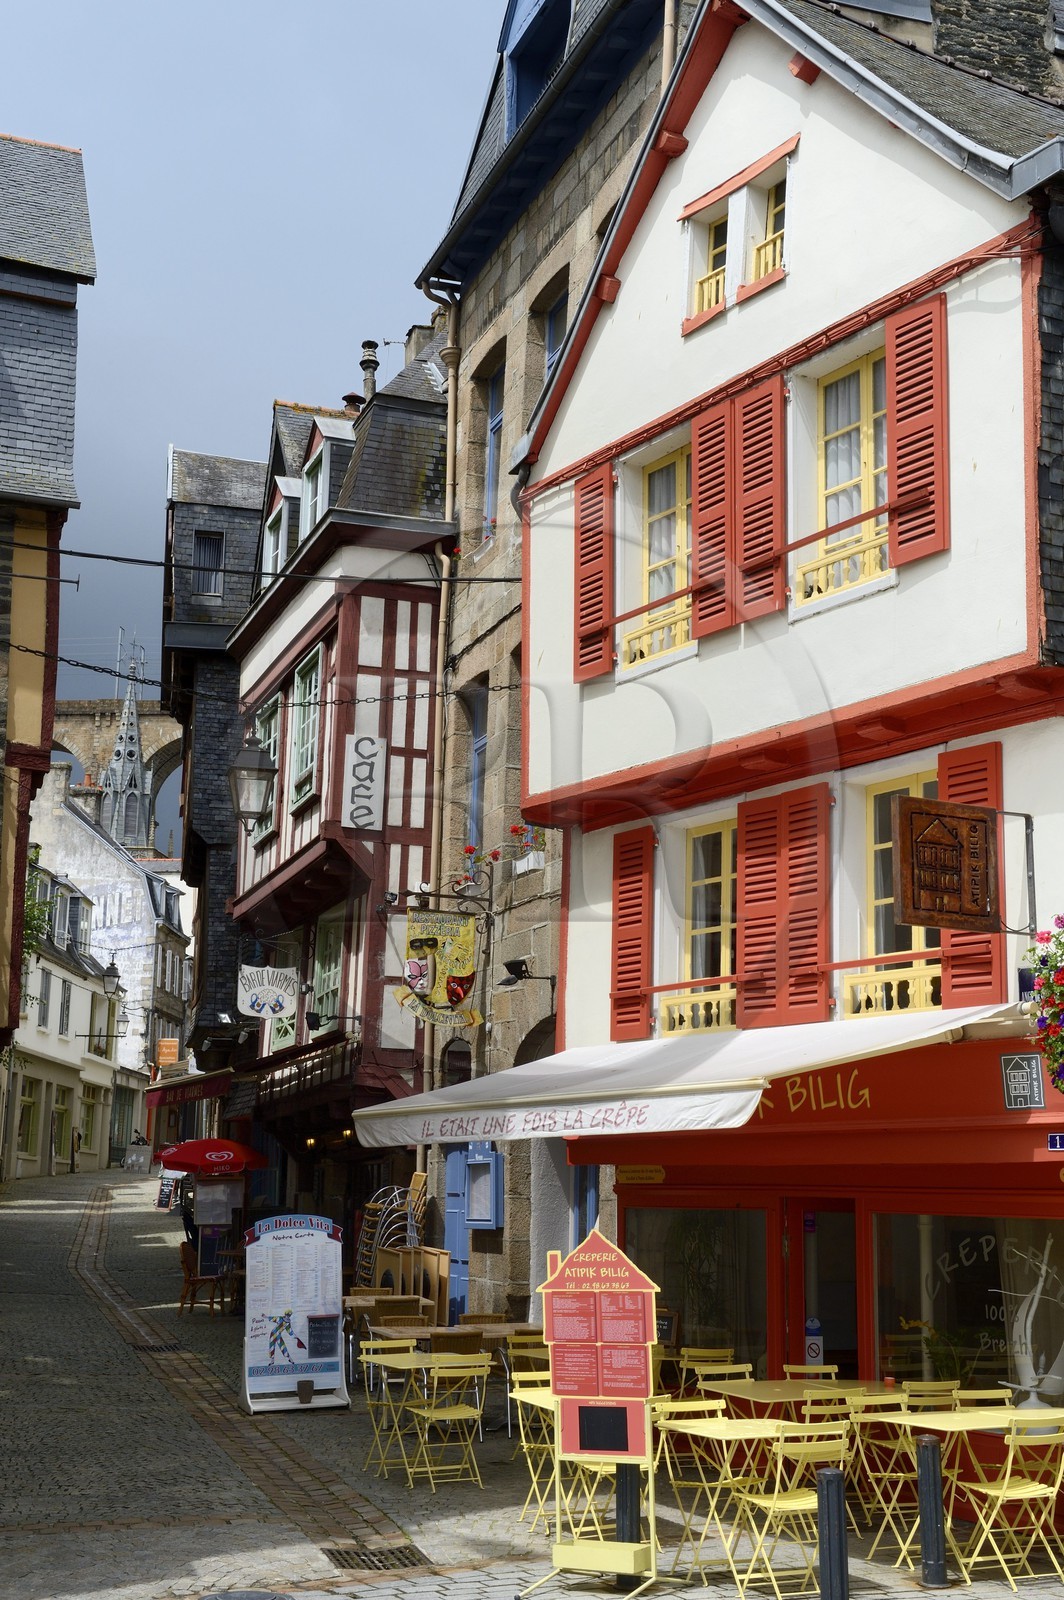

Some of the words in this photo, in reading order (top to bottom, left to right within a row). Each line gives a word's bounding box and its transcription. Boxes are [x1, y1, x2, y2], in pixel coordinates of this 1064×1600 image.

[969, 824, 979, 860] BILIG
[970, 864, 981, 907] ATIPIK
[420, 925, 460, 937] PIZZERIA
[785, 1067, 871, 1113] BILIG
[420, 1120, 434, 1138] IL
[439, 1116, 480, 1137] ETAIT
[482, 1113, 516, 1135] UNE
[522, 1109, 558, 1132] FOIS
[563, 1109, 584, 1130] LA
[589, 1100, 650, 1130] CRÊPE
[257, 1222, 271, 1234] La
[274, 1217, 305, 1229] Dolce
[308, 1217, 330, 1231] Vita
[272, 1234, 293, 1242] Notre
[573, 1252, 618, 1263] CREPERIE
[564, 1267, 597, 1279] ATIPIK
[600, 1266, 630, 1278] BILIG
